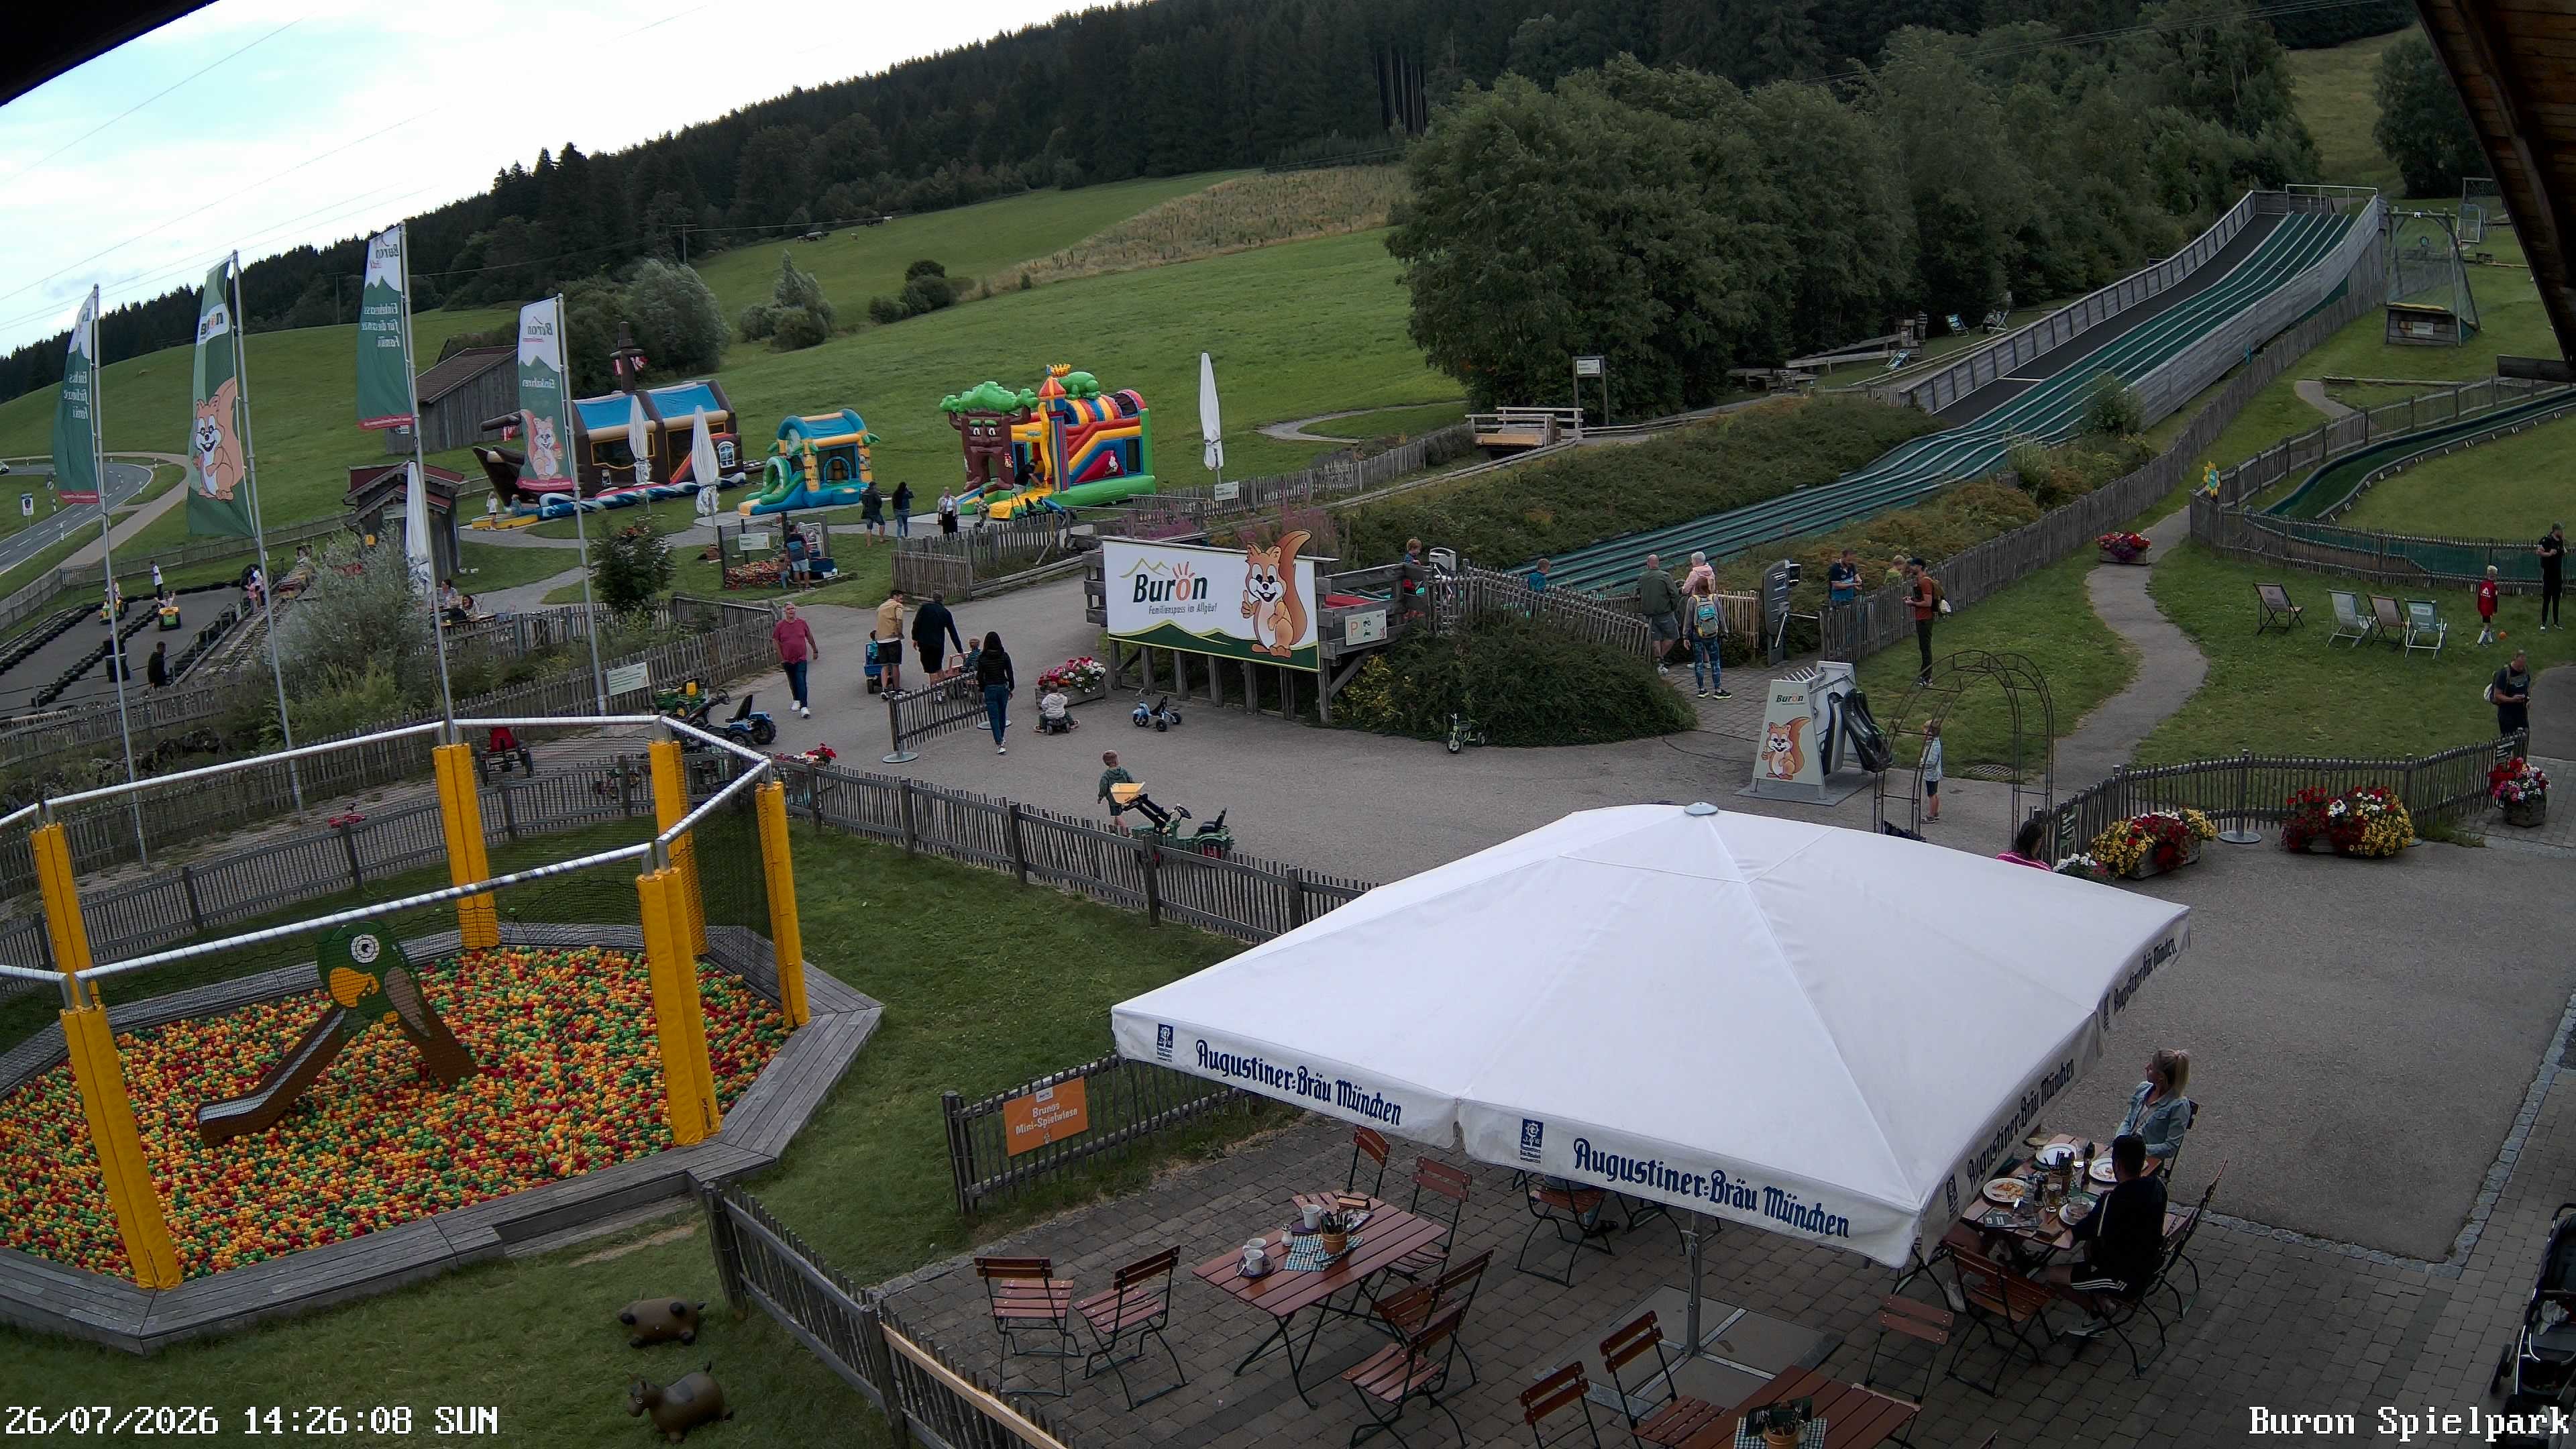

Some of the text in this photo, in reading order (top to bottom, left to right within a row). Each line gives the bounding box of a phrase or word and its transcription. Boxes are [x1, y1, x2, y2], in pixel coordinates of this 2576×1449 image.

[1132, 573, 1208, 603] Buron
[1350, 621, 1358, 637] P
[1776, 694, 1804, 703] Buron
[2040, 1059, 2074, 1107] München
[1032, 1103, 1061, 1118] Brunos
[1335, 1079, 1401, 1126] München
[1016, 1108, 1078, 1135] Mini-Spielwiese
[1763, 1186, 1851, 1239] München
